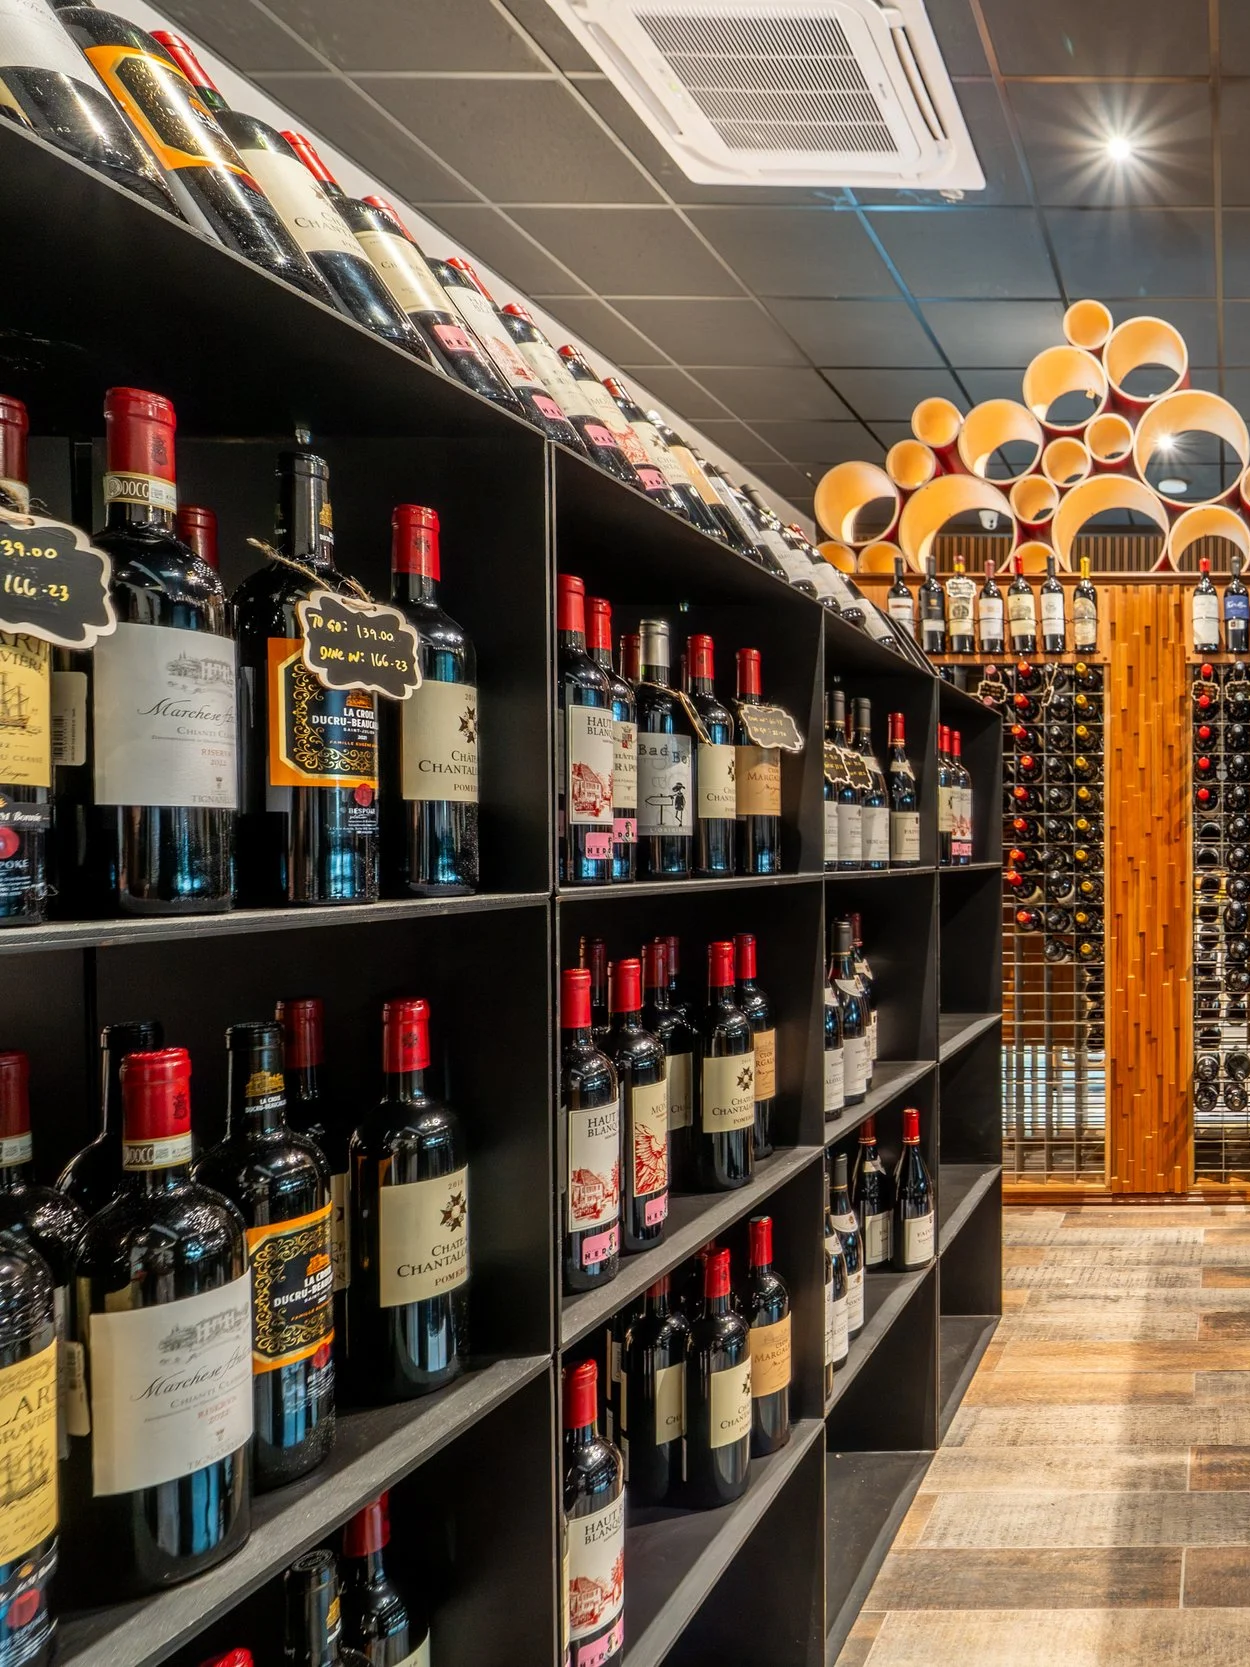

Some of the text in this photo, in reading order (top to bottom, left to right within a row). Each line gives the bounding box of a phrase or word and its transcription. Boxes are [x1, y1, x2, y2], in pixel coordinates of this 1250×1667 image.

[137, 698, 220, 721] Marchese
[343, 707, 354, 718] LA
[638, 744, 668, 756] Bad
